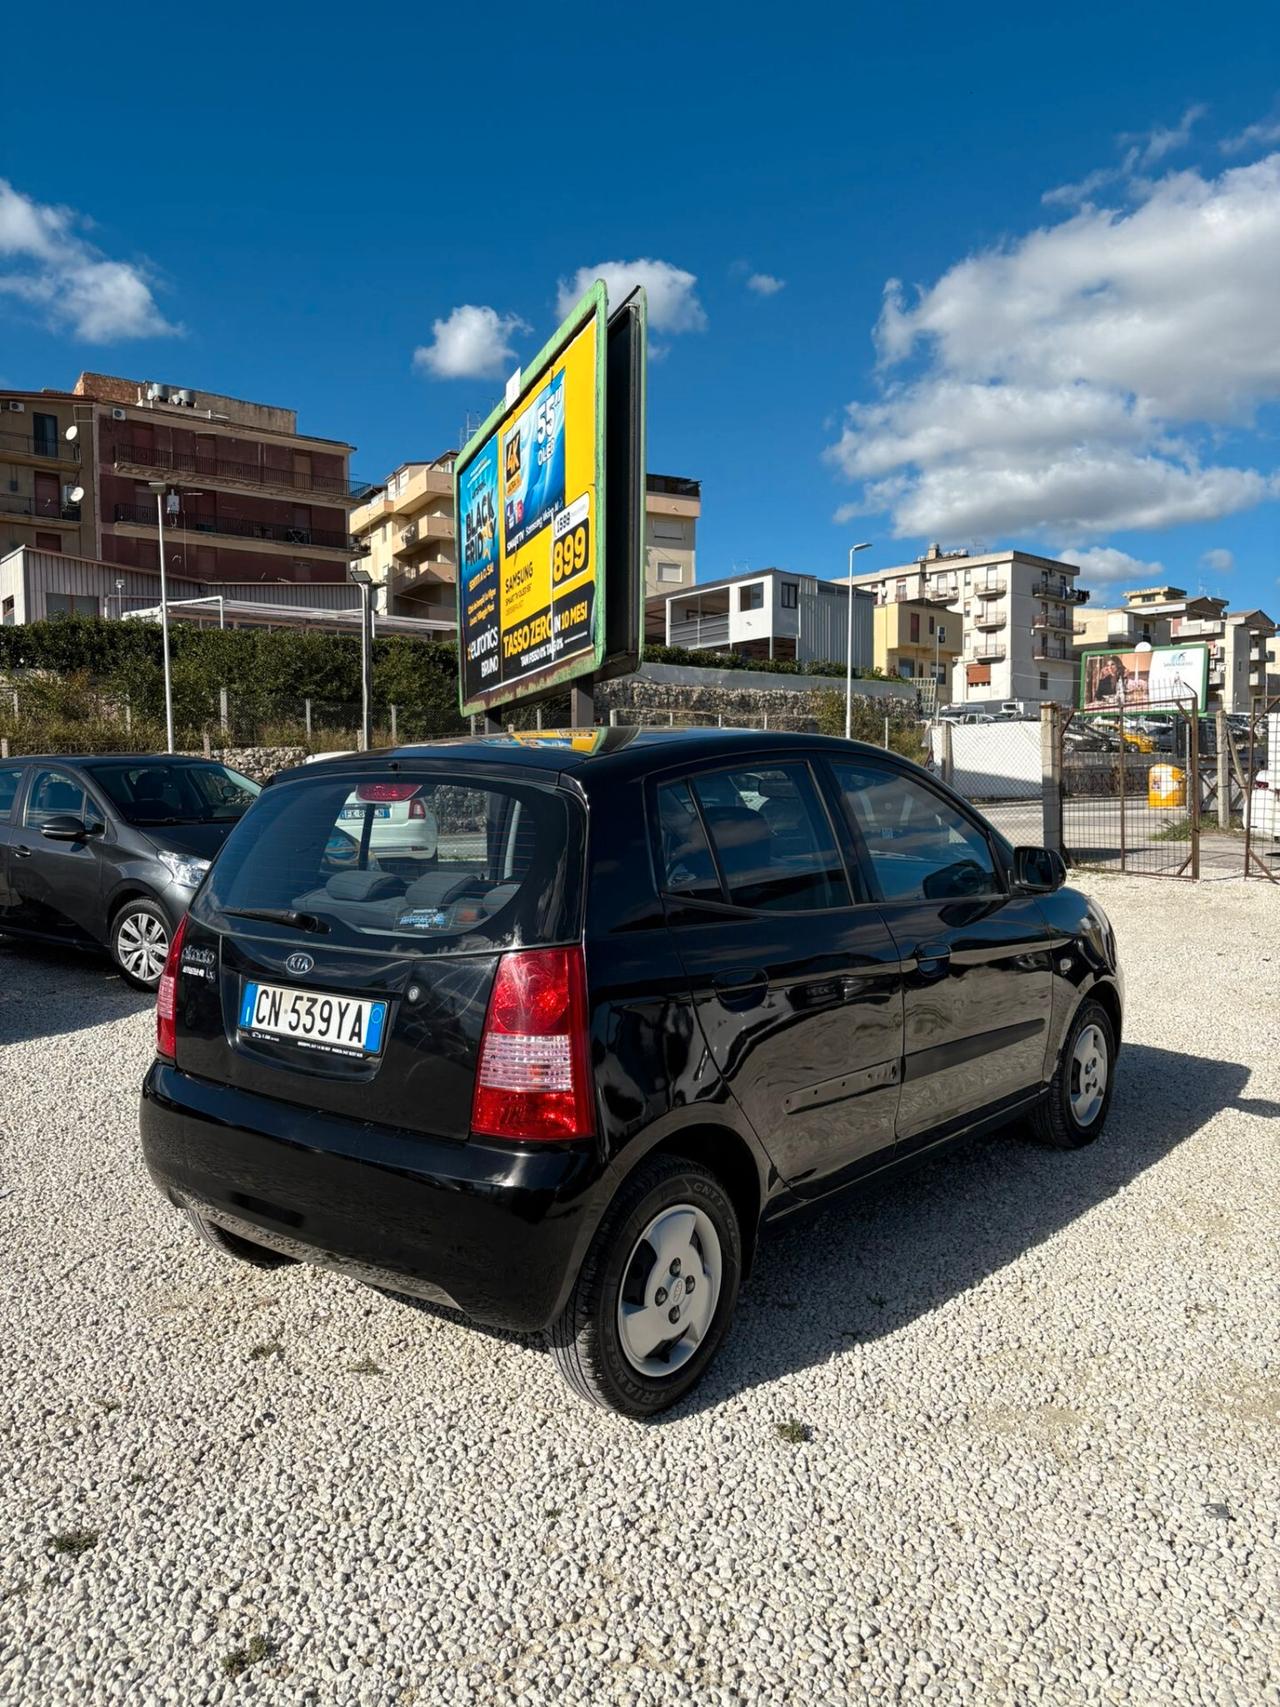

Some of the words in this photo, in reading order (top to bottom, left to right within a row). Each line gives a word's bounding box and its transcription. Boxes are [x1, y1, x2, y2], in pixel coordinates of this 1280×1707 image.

[507, 434, 520, 474] 4K
[466, 489, 495, 540] BLACK
[526, 517, 542, 535] Samsung
[554, 526, 586, 582] 899
[506, 562, 534, 594] SAMSUNG
[470, 624, 498, 660] euronics
[504, 625, 530, 658] TASSO
[530, 611, 552, 646] ZERO
[554, 614, 561, 633] IN
[561, 610, 570, 630] 10
[570, 600, 588, 626] MESI
[480, 654, 499, 678] BRUNO
[290, 956, 308, 970] KIA
[256, 989, 284, 1027] CN
[288, 996, 362, 1044] 539YA
